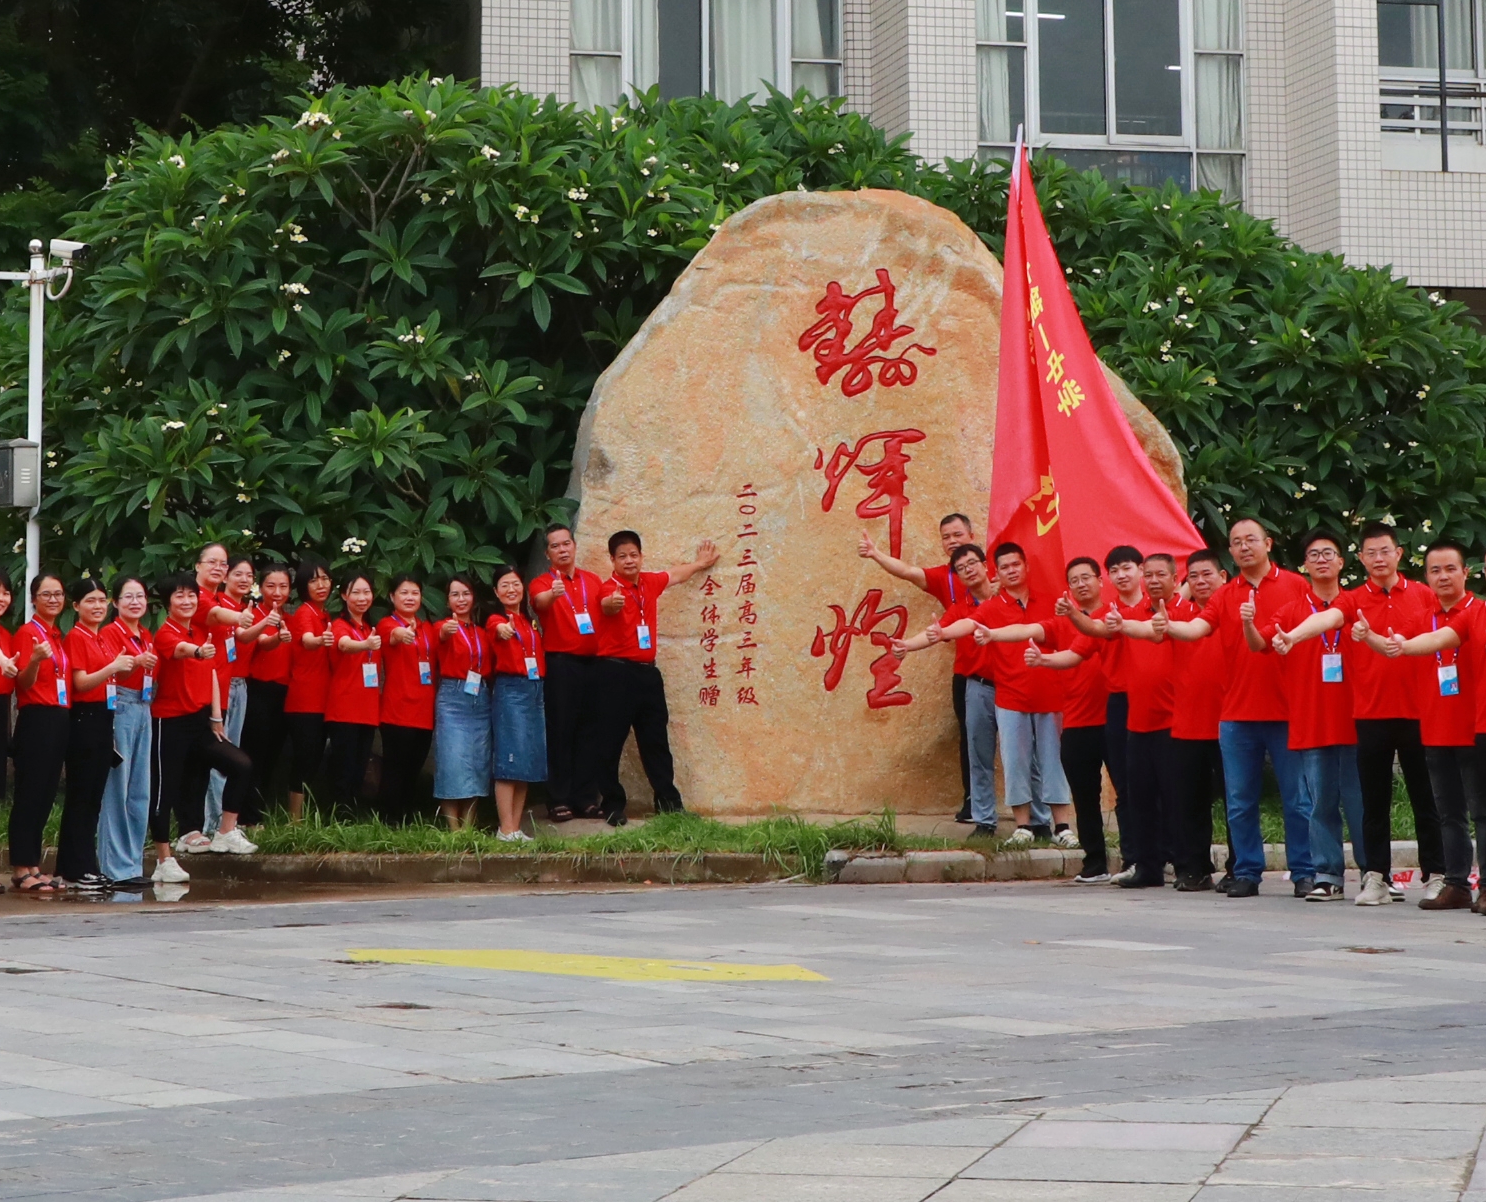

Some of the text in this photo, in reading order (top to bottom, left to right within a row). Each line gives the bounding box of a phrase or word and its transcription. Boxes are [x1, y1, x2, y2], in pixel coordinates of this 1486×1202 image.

[699, 574, 721, 707] 全体学生赠
